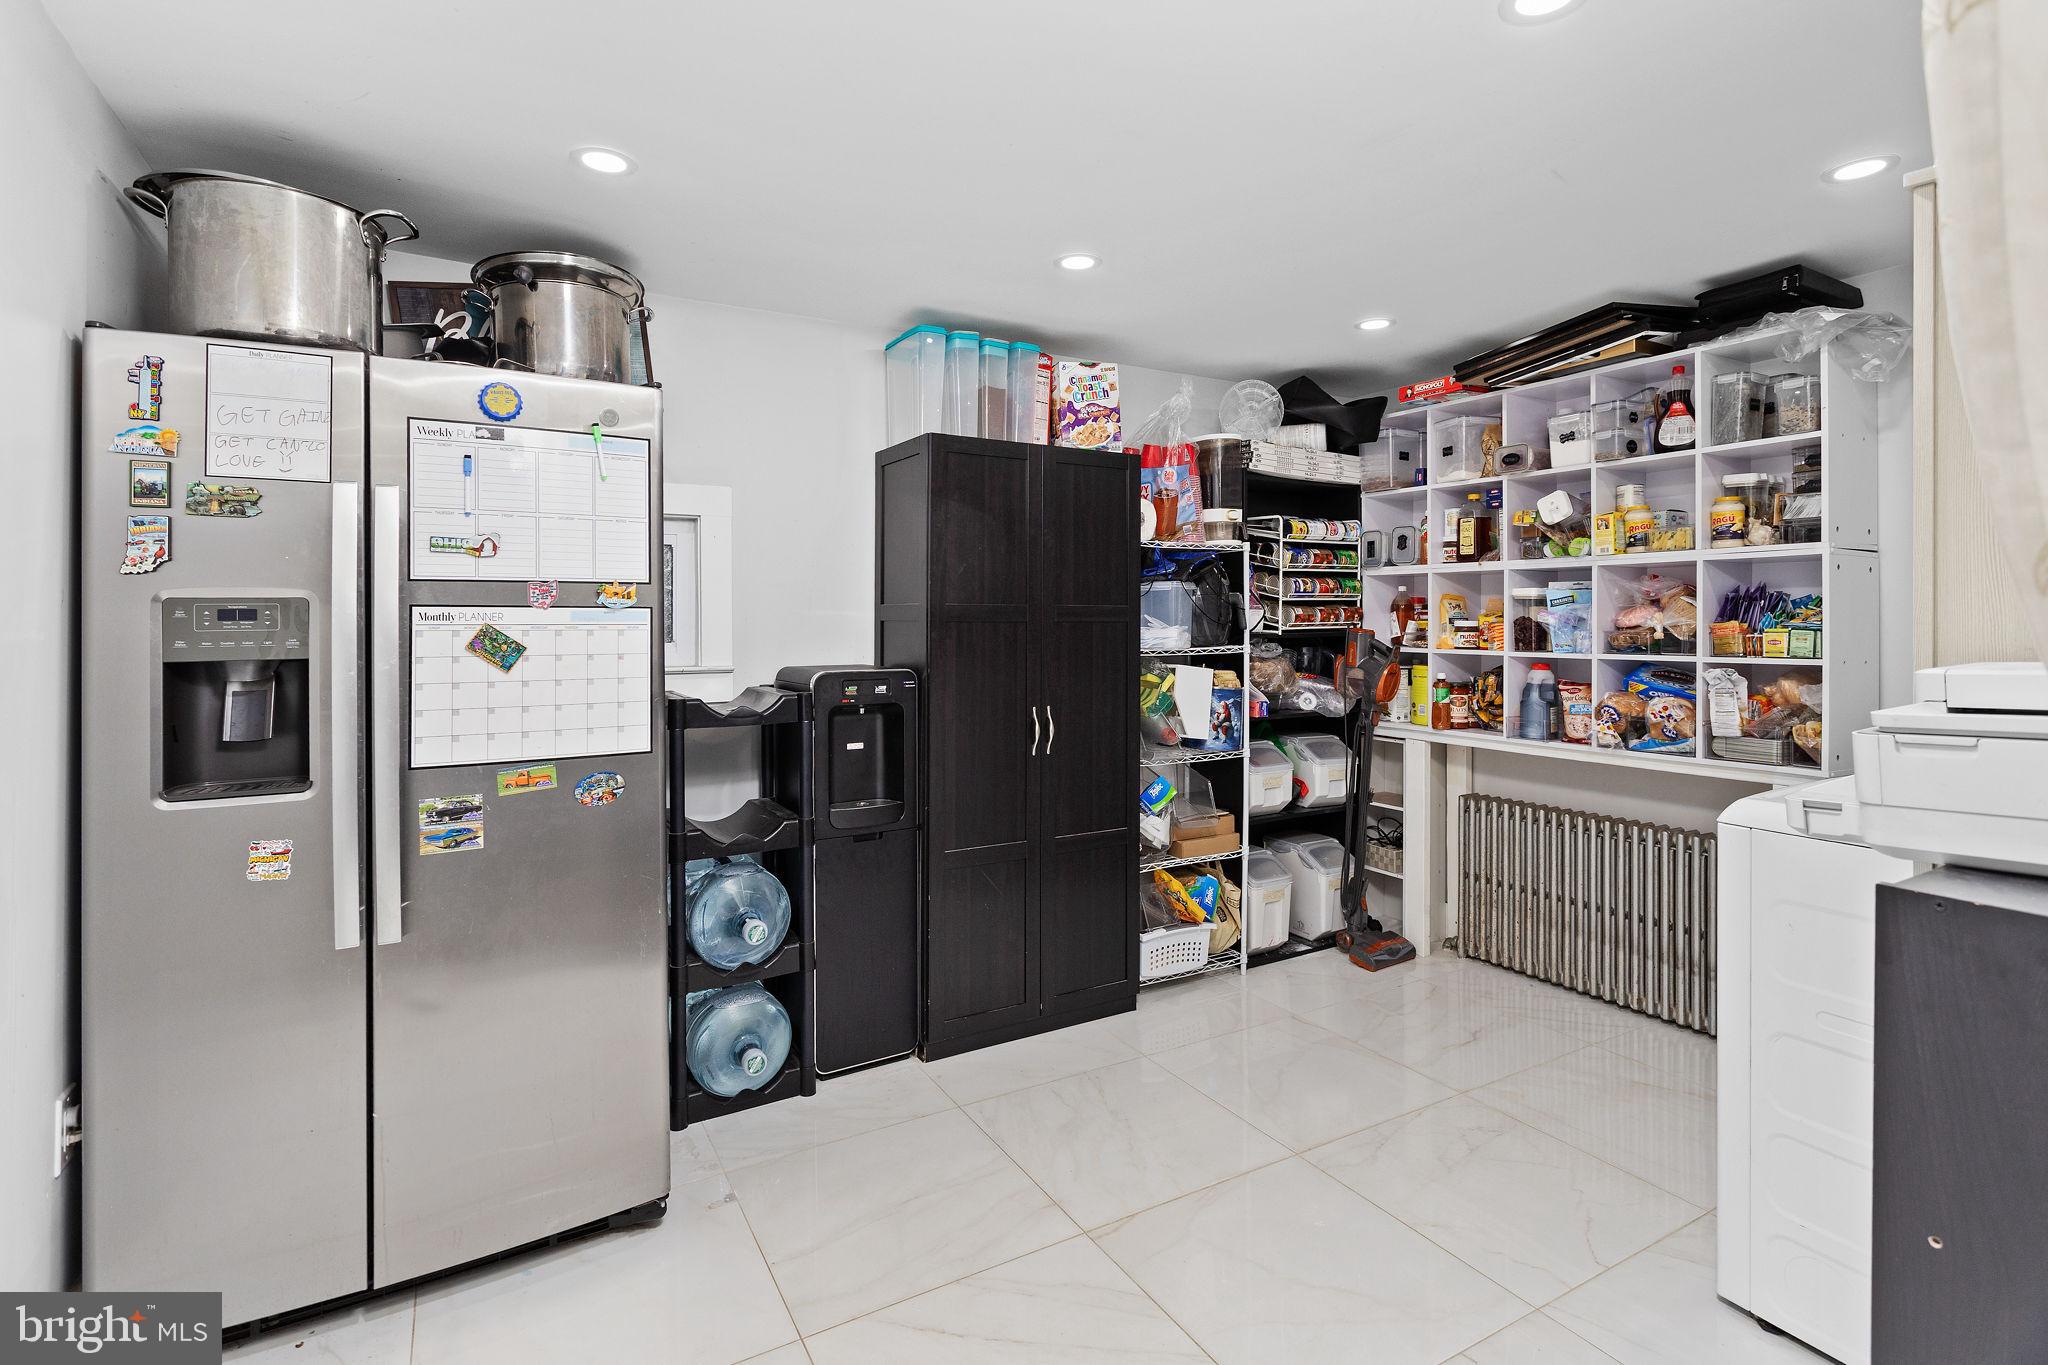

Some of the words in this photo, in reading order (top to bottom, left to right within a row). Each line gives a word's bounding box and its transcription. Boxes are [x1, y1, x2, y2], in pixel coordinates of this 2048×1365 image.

[1069, 373, 1108, 385] Cinnamon
[1077, 381, 1103, 393] Toast
[1415, 380, 1445, 393] MONOPOLY
[1073, 388, 1110, 402] Crunch
[217, 405, 271, 425] GET
[416, 425, 453, 438] Weekly
[215, 435, 254, 449] GET
[216, 454, 266, 468] LOVE
[418, 612, 456, 623] Monthly
[458, 612, 504, 622] PLANNER
